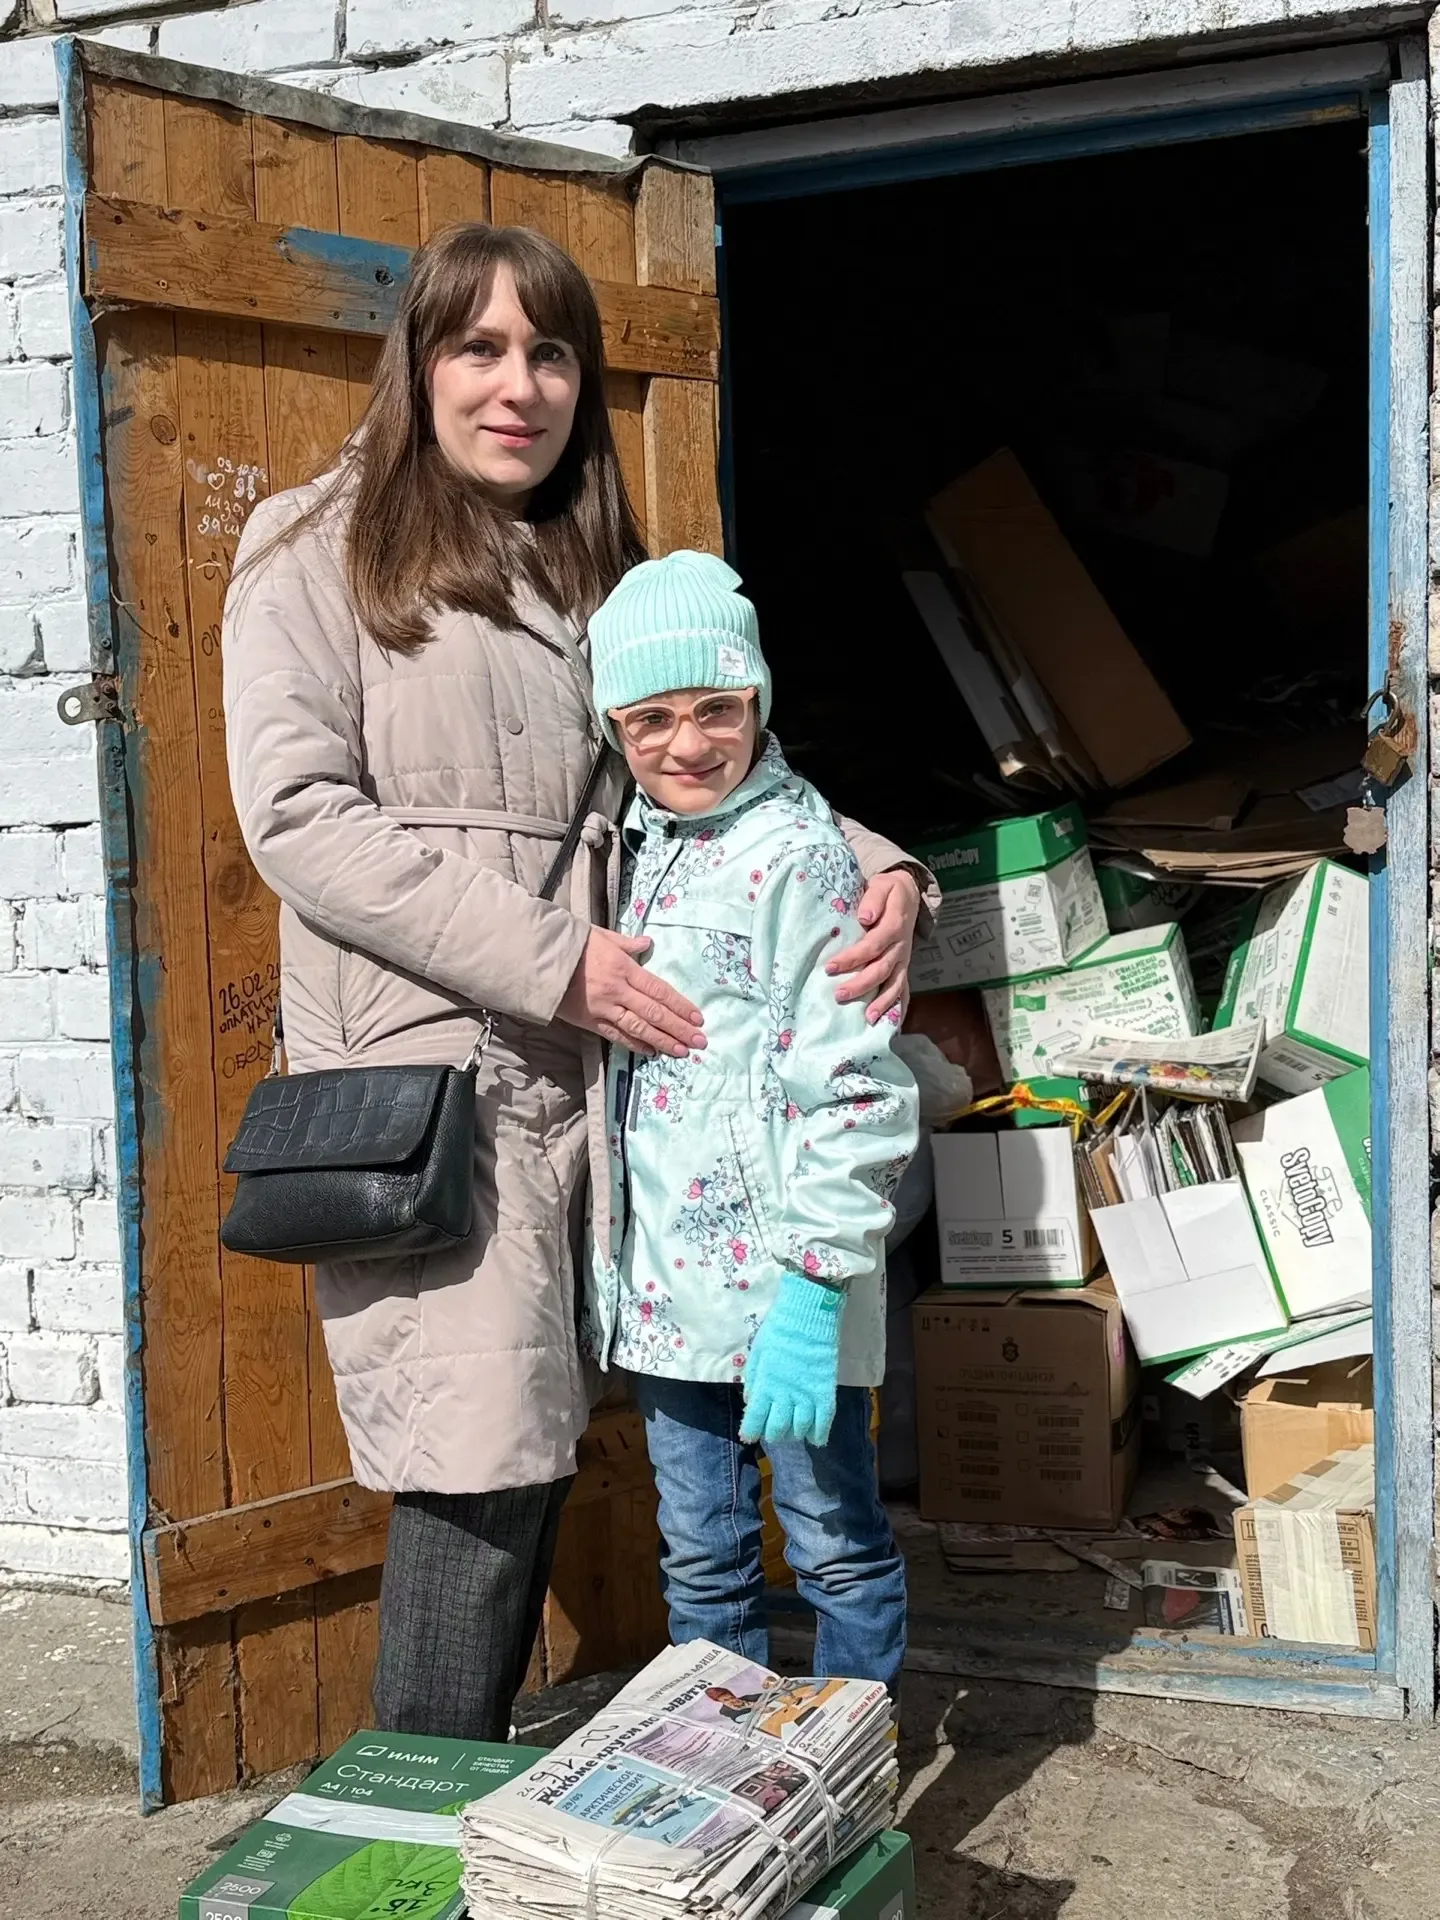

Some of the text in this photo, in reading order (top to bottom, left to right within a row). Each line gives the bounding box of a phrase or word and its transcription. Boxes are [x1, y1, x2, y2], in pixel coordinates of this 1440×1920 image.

[1259, 1189, 1281, 1238] CLASSIC
[1280, 1147, 1334, 1248] SvetoCopy
[1002, 1229, 1013, 1243] 5
[691, 1648, 722, 1674] АФИША
[638, 1678, 713, 1729] поывать!
[387, 1750, 440, 1765] ИЛИМ
[337, 1764, 470, 1794] Стандарт
[579, 1769, 635, 1819] АРКТИЧЕСКОЕ
[588, 1772, 646, 1822] ПУТЕШЕСТВИЕ
[219, 1881, 262, 1895] 2500
